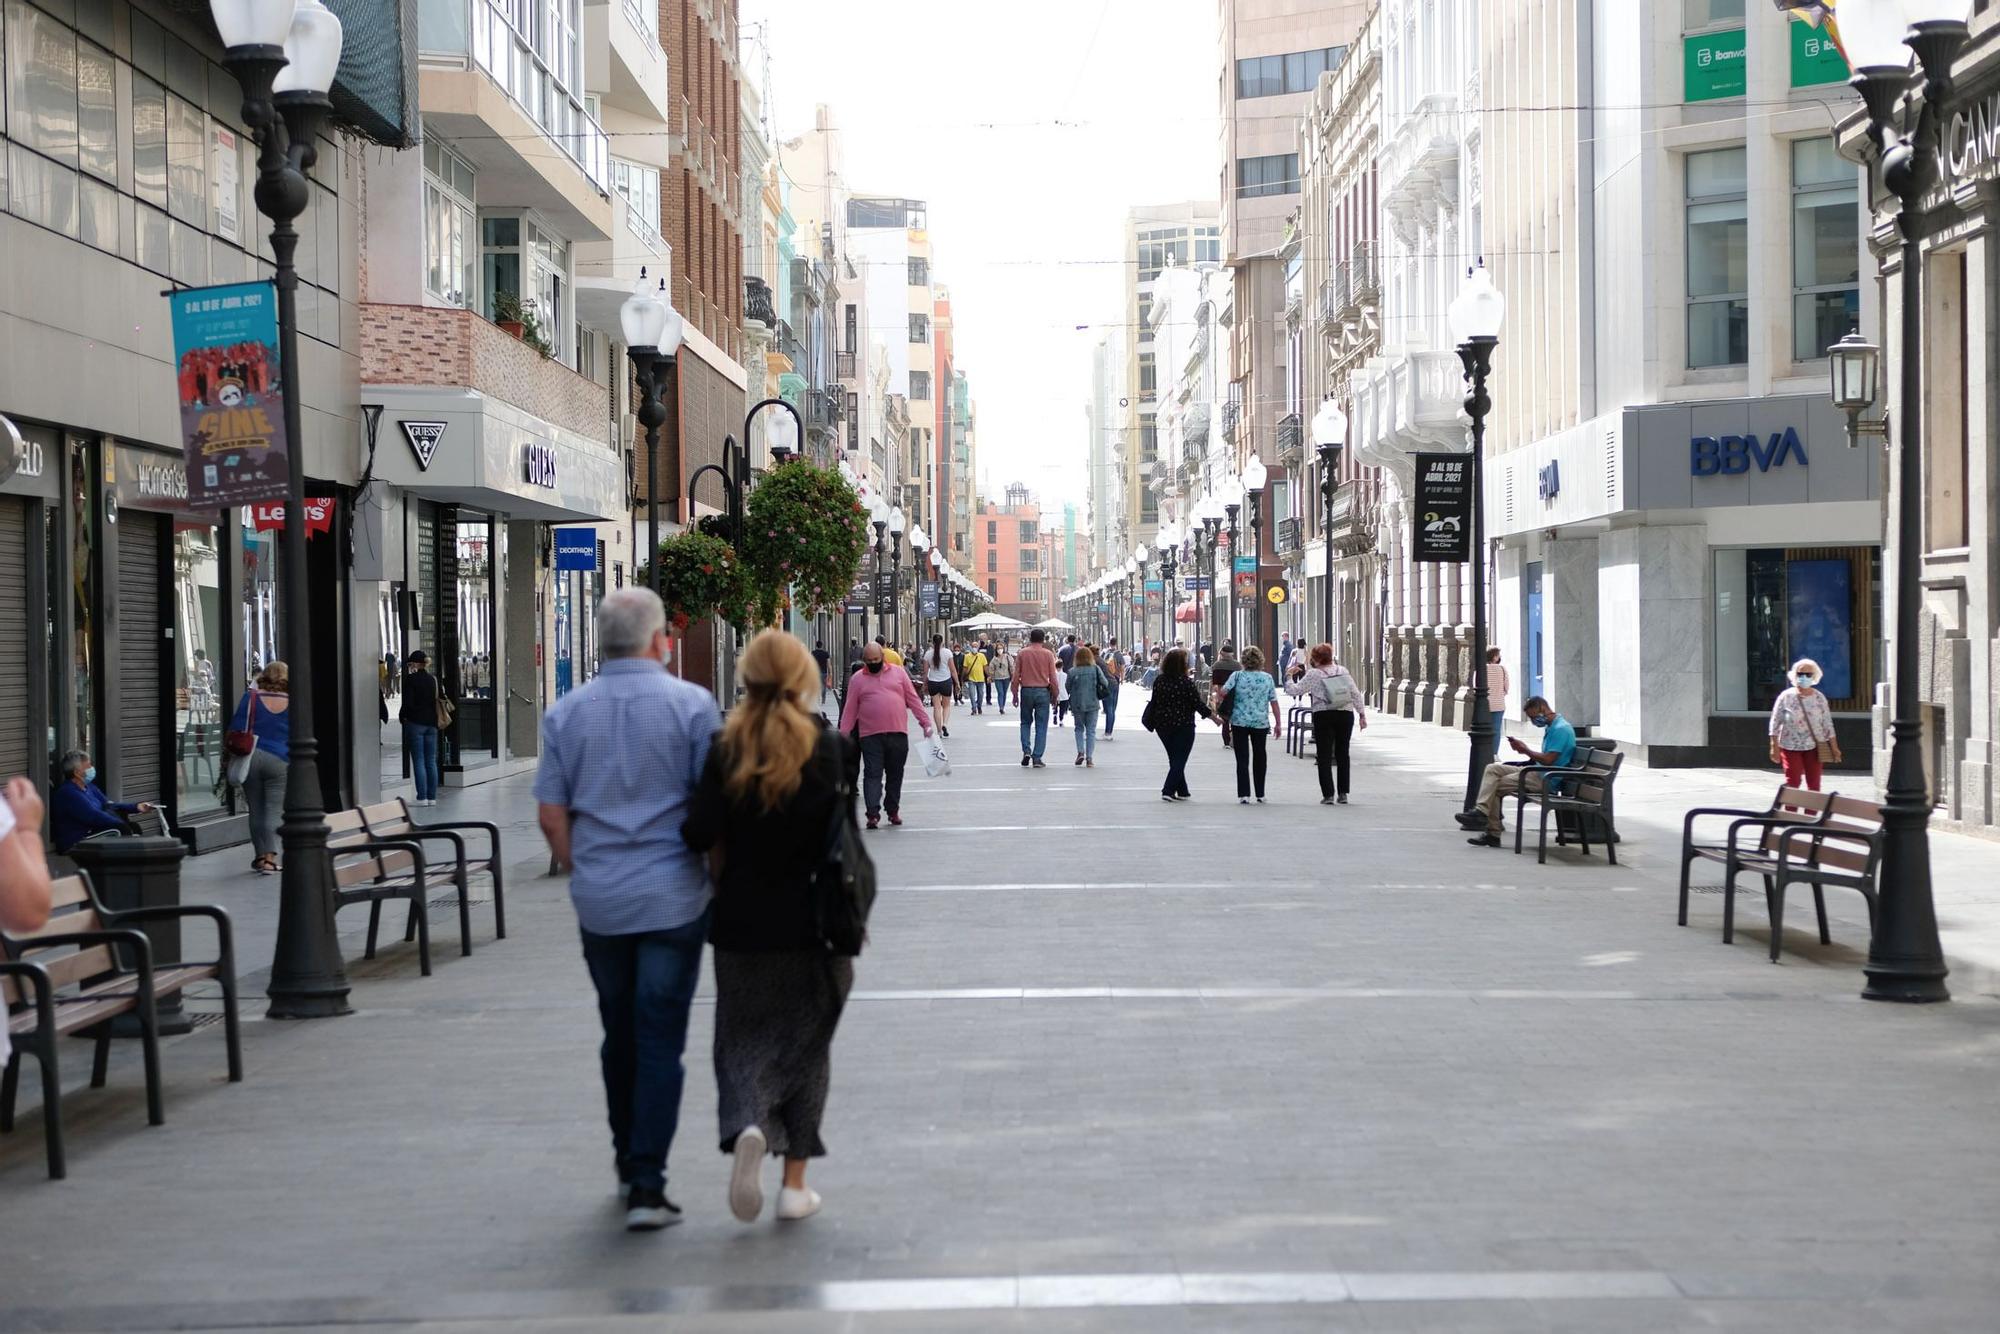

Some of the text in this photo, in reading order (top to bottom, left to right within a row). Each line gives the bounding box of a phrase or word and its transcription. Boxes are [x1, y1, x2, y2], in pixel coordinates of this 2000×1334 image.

[1715, 48, 1746, 61] ibanwa
[198, 407, 275, 442] CINE
[411, 426, 440, 437] GUESS
[18, 440, 43, 476] ELD
[529, 443, 558, 488] GUESS
[1431, 462, 1437, 471] 9
[1437, 462, 1445, 471] AL
[1454, 462, 1463, 471] DE
[1691, 426, 1809, 476] BBVA
[138, 464, 189, 499] women'se
[1425, 472, 1462, 482] ABRIL 2021
